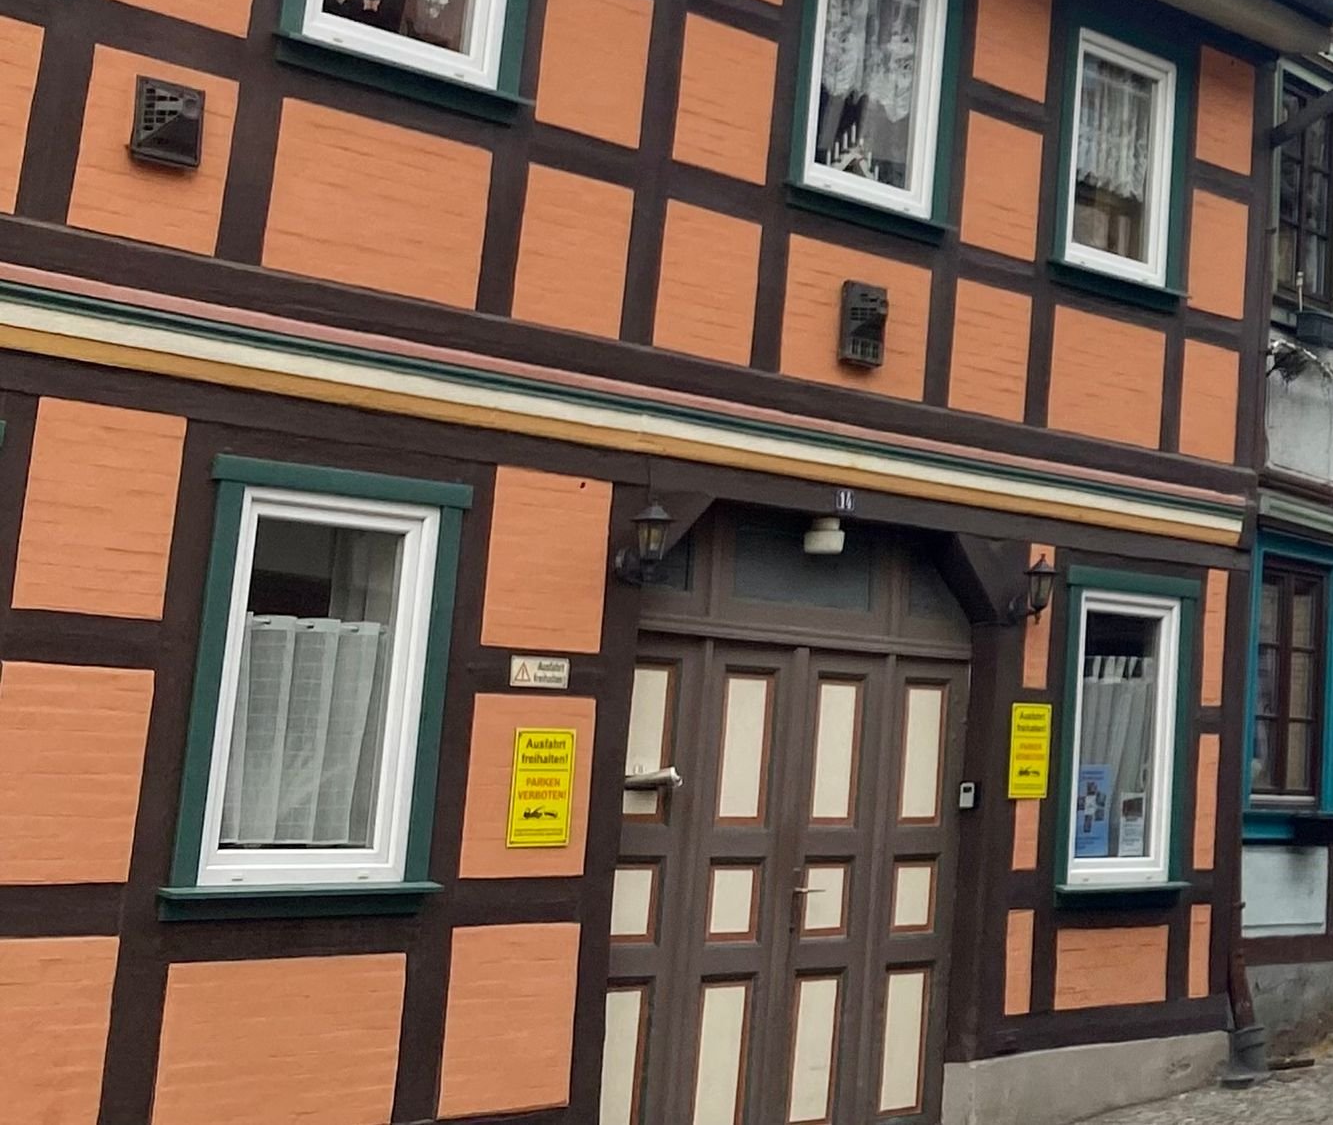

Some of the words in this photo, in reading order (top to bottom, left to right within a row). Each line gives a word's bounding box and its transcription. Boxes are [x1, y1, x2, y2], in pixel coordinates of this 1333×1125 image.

[526, 738, 567, 750] Ausfahrt
[521, 753, 569, 764] freihalten!
[525, 777, 561, 788] PARKEN
[517, 790, 567, 801] VERBOTEN!
